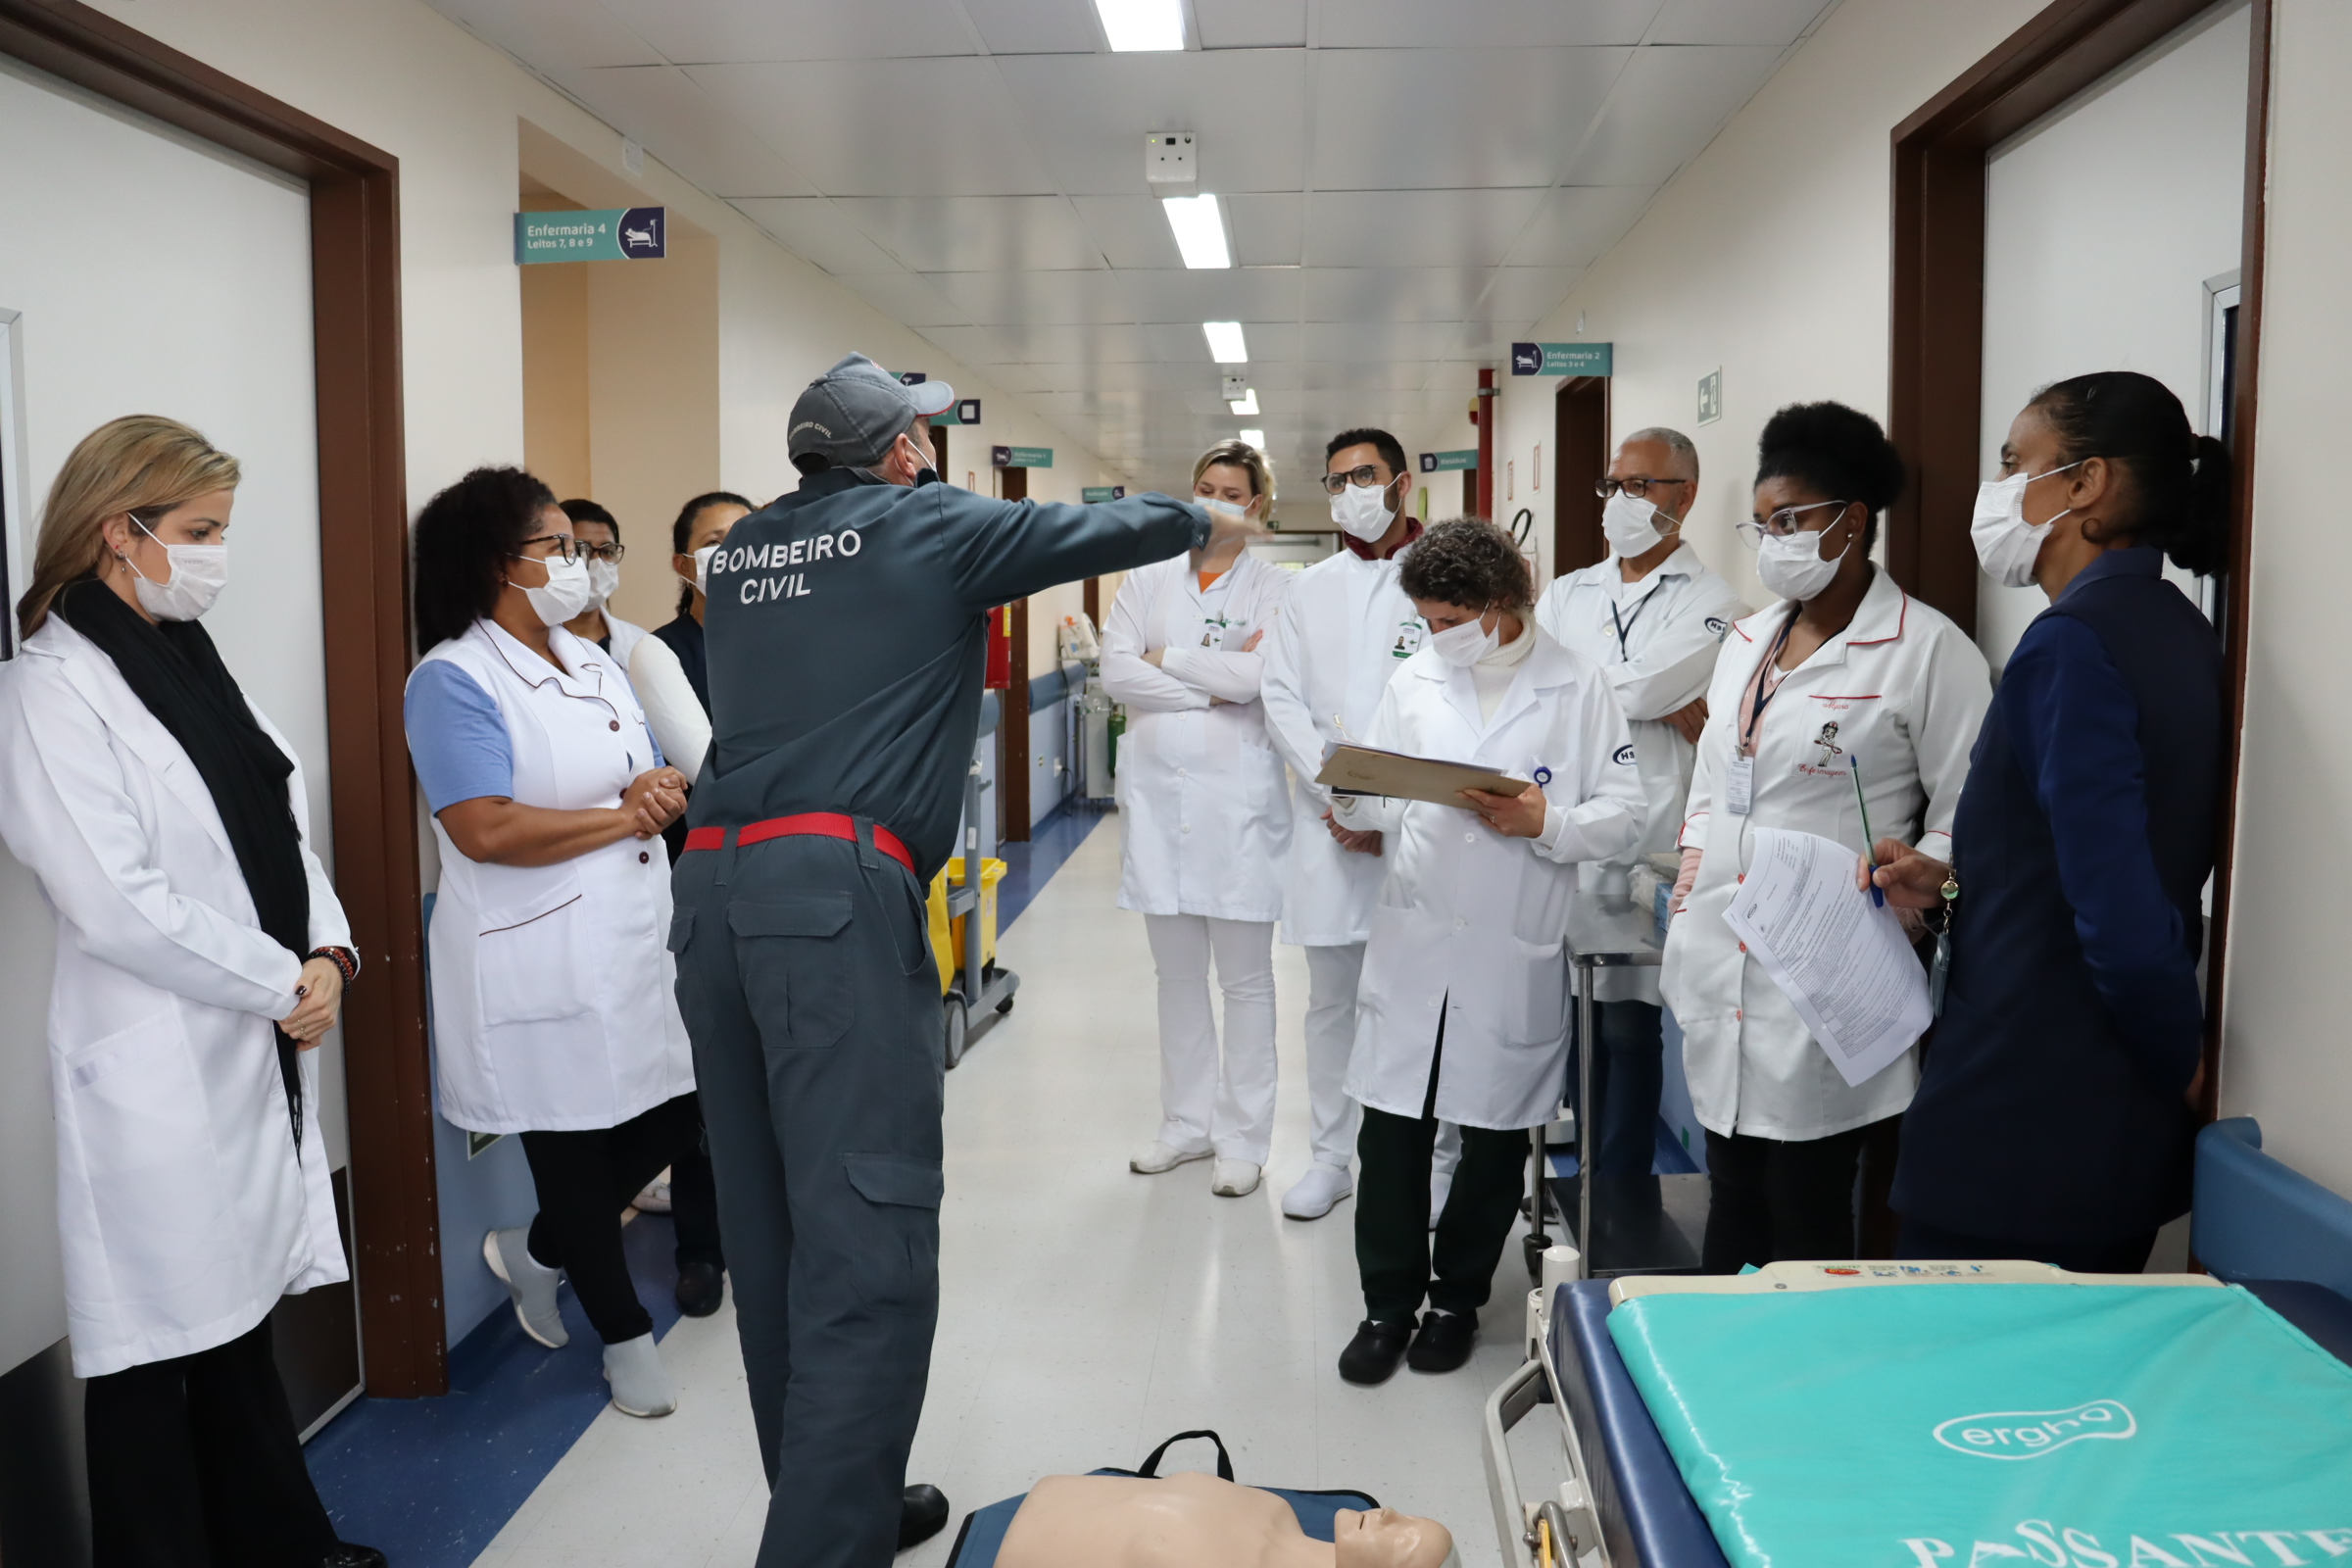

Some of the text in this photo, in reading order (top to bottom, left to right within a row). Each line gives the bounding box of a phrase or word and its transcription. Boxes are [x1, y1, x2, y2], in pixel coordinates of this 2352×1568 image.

[527, 223, 607, 236] Enfermaria 4
[527, 239, 557, 248] Leitos
[559, 239, 566, 248] 7,
[568, 238, 575, 248] 8
[586, 237, 593, 247] 9
[814, 422, 832, 439] CIVIL
[711, 529, 861, 574] BOMBEIRO
[740, 572, 811, 605] CIVIL
[1798, 763, 1846, 778] Enfermagem
[1961, 1407, 2113, 1447] ergho
